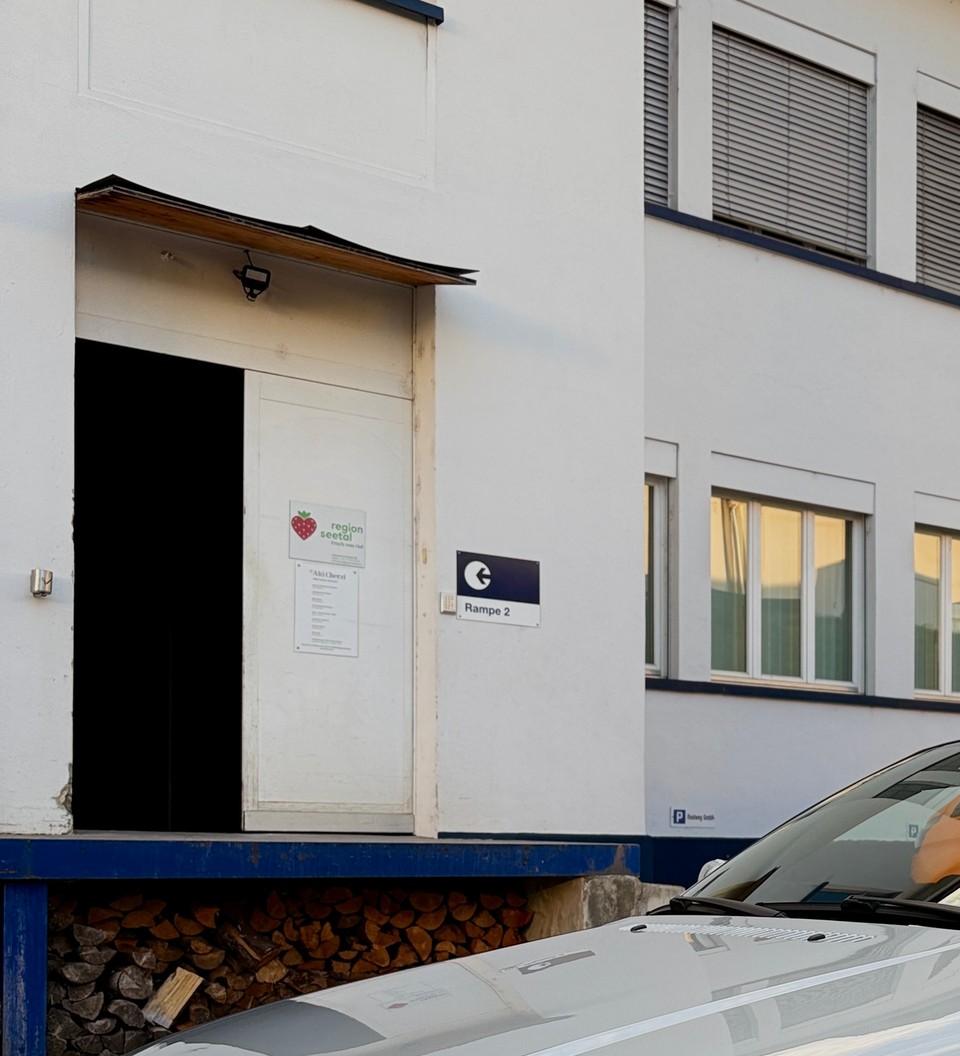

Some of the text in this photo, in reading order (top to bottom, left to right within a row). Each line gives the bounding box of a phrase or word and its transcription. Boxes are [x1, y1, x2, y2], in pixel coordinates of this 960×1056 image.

[331, 523, 364, 534] region
[320, 530, 352, 542] seetal
[465, 602, 510, 616] Rampe 2
[676, 811, 684, 823] P
